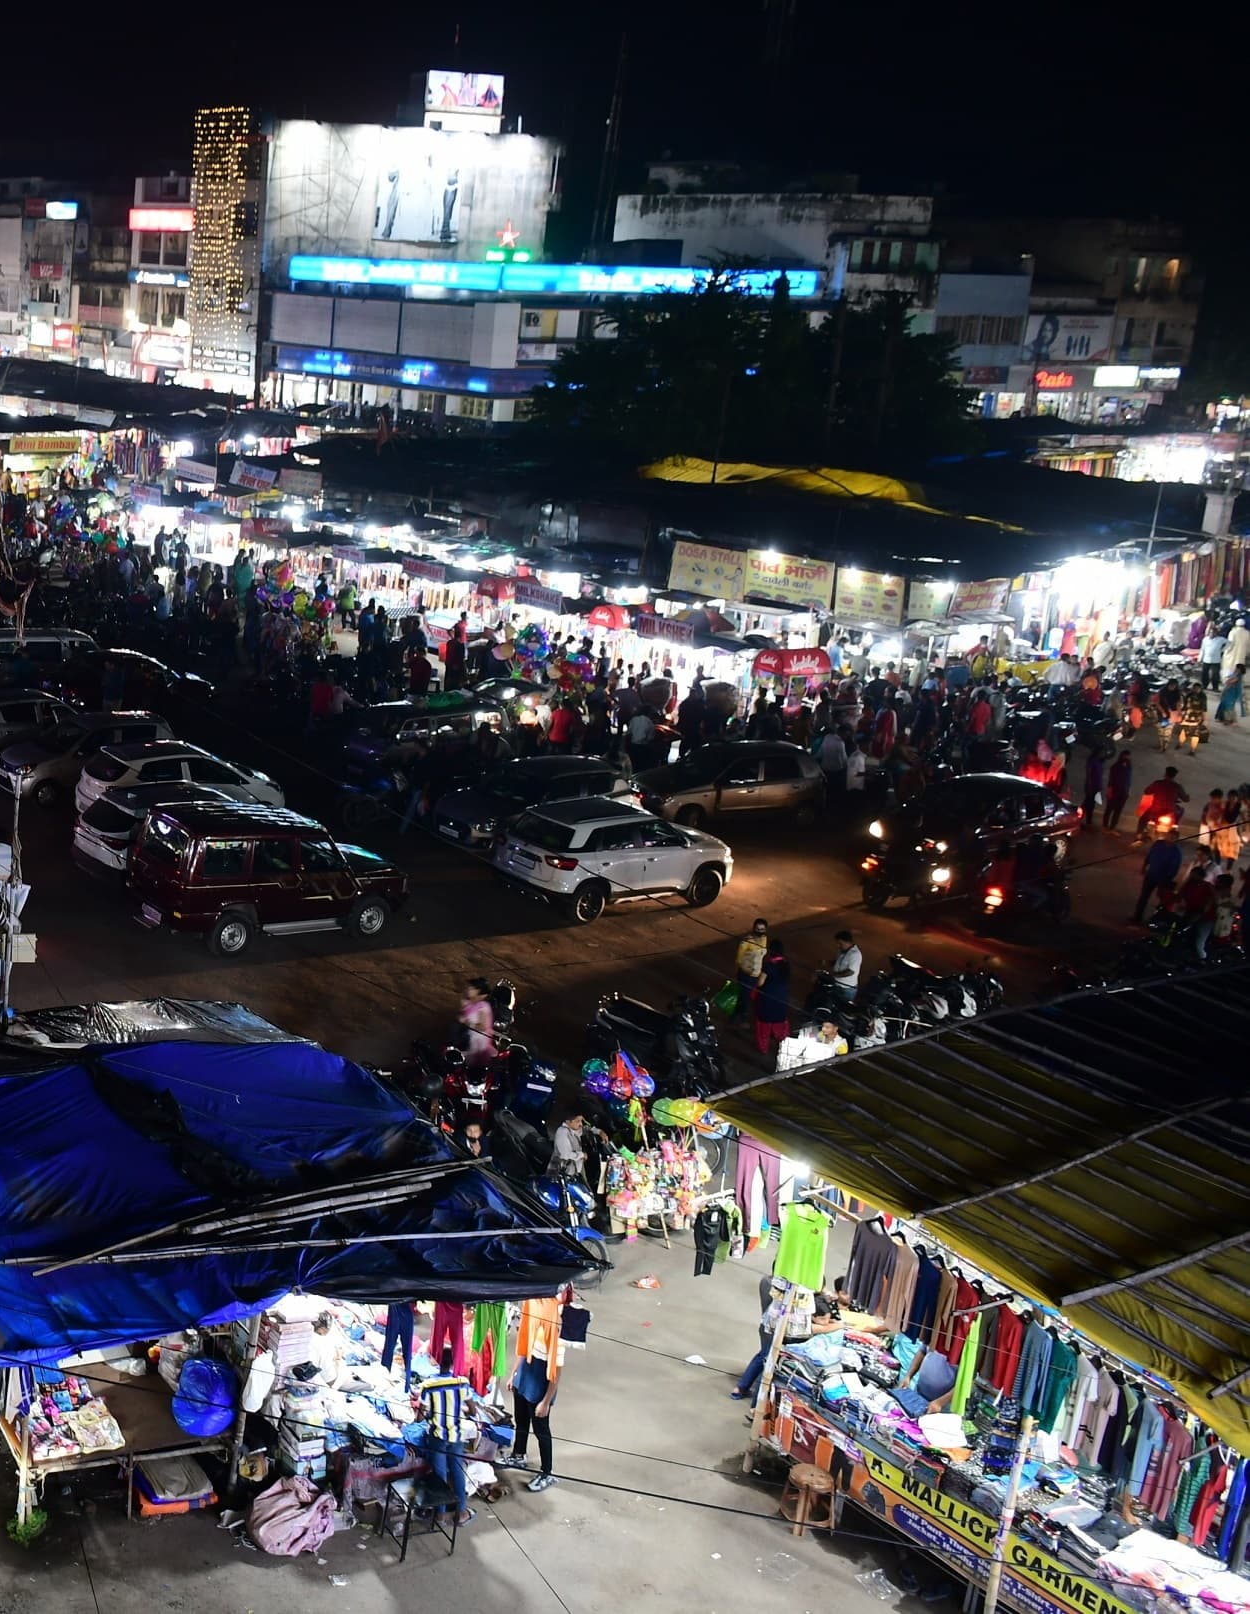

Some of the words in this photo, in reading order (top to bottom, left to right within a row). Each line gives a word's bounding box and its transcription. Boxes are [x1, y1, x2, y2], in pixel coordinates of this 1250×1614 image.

[14, 440, 36, 450] Mini
[37, 440, 77, 450] Bombay
[678, 545, 707, 560] DOSA
[710, 550, 742, 568] STALL
[901, 1474, 998, 1545] MALLICK
[1012, 1544, 1128, 1614] GARMEN
